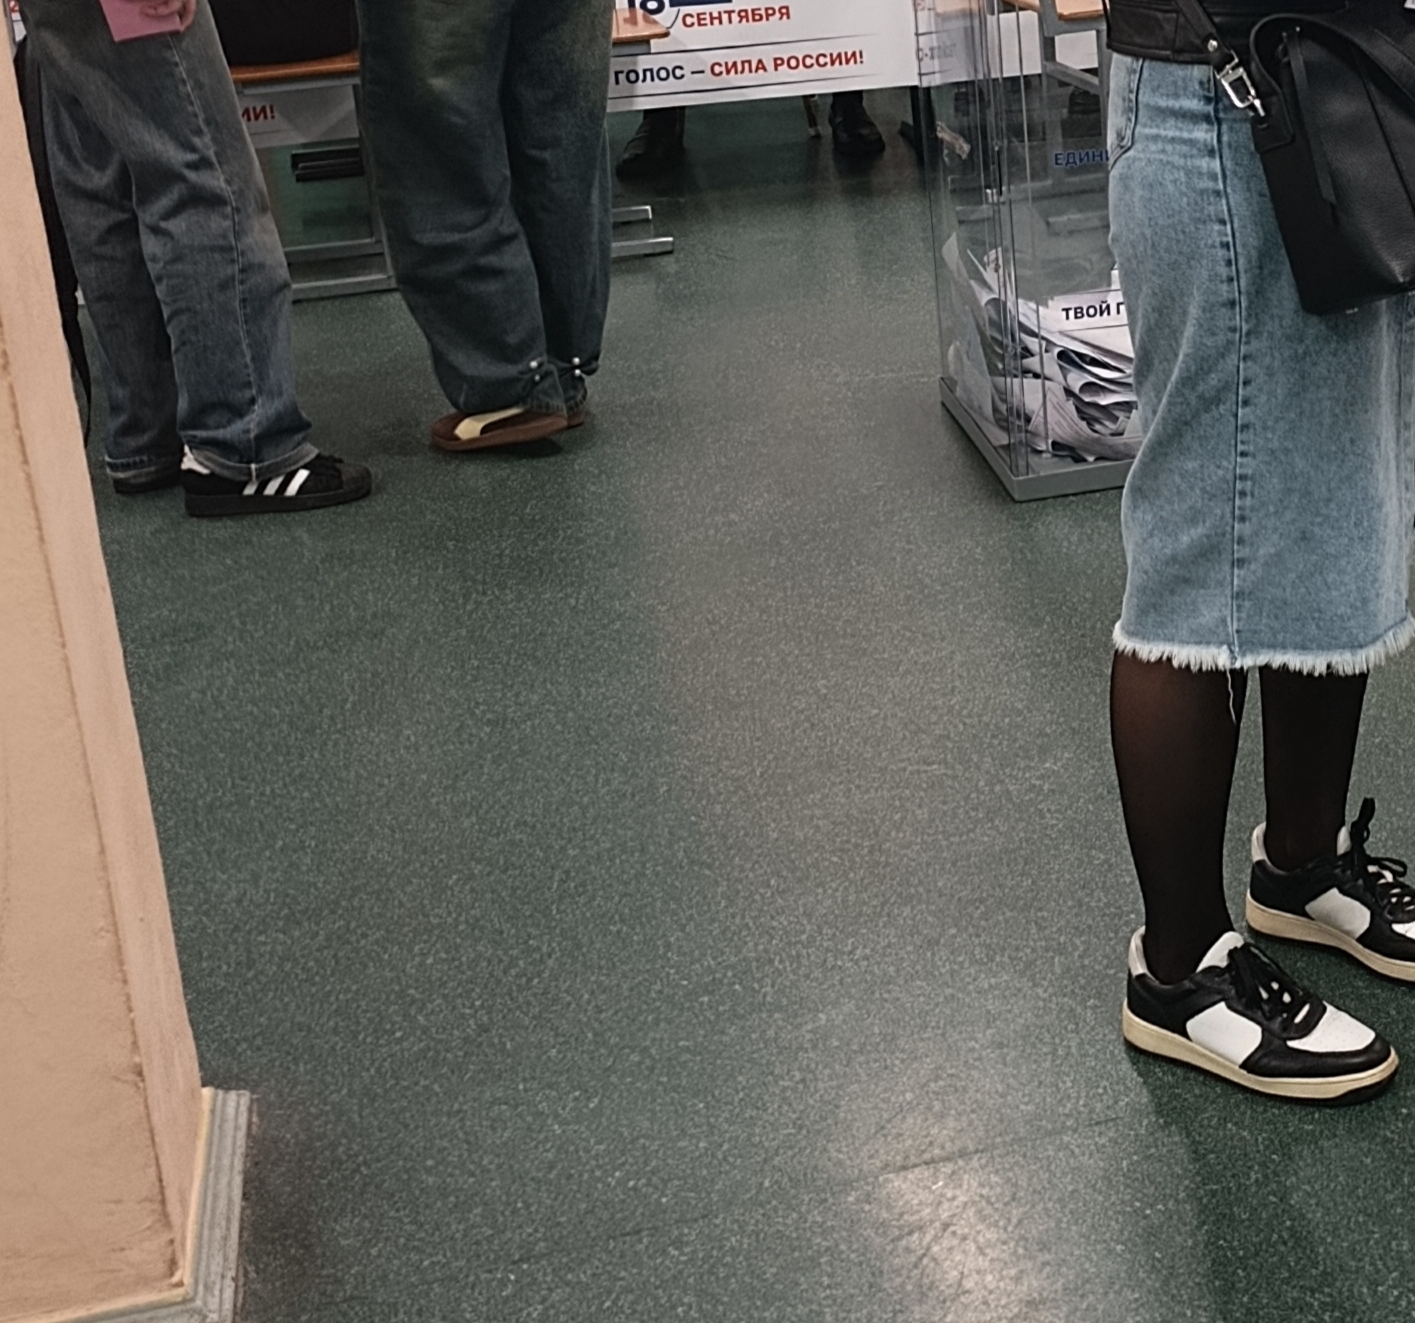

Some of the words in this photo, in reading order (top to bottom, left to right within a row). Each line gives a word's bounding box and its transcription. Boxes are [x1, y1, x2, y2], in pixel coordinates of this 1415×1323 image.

[681, 5, 791, 28] СЕНТЯБРЯ
[614, 65, 685, 86] ГОЛОС
[709, 56, 767, 78] СИЛА
[773, 50, 864, 73] РОССИИ!
[1062, 300, 1111, 321] ТВОЙ
